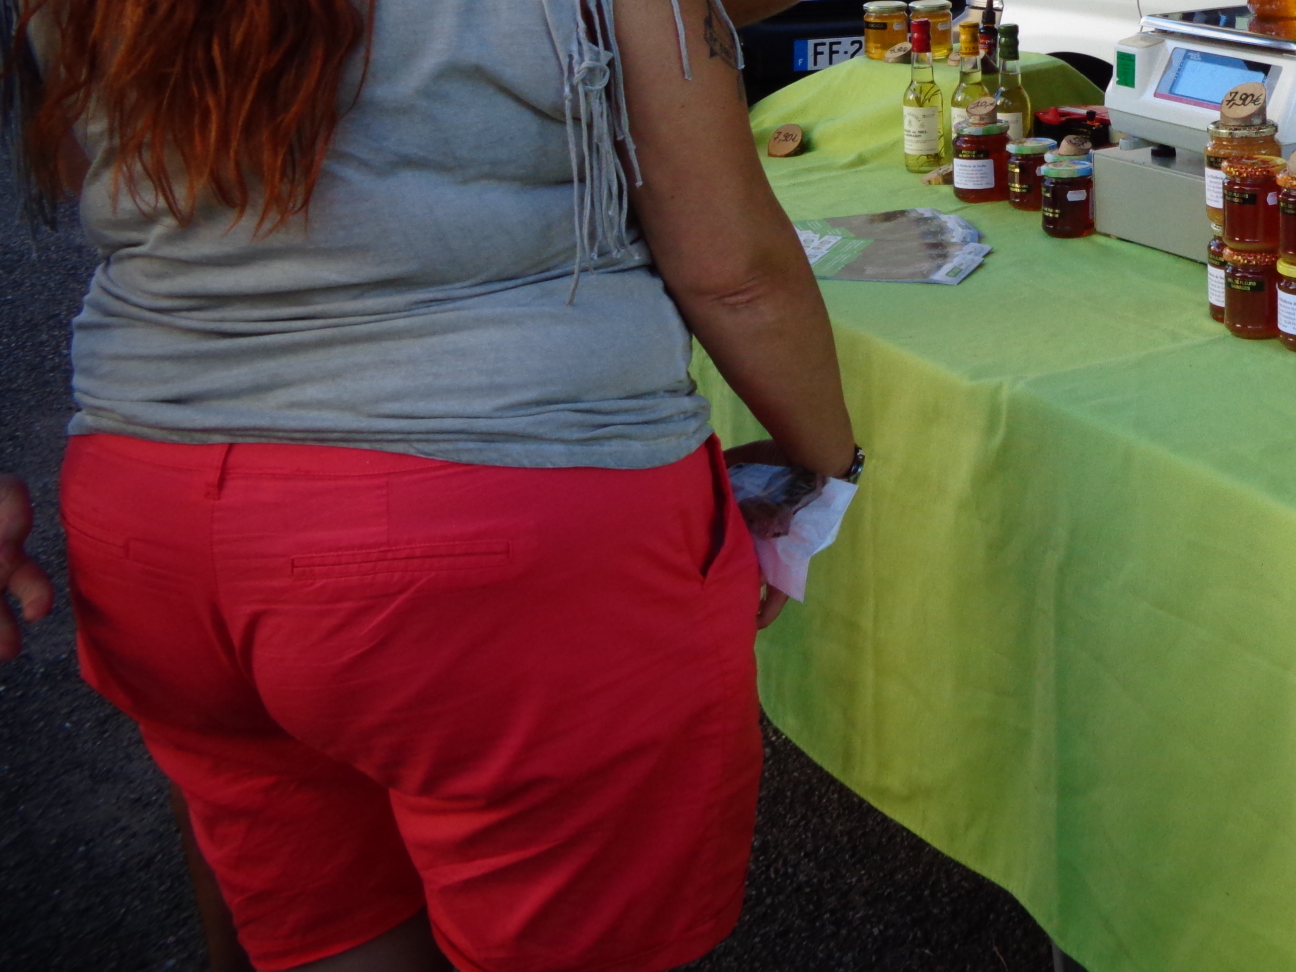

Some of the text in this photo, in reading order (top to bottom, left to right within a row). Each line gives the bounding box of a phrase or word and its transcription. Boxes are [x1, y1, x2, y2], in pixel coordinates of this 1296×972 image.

[798, 58, 804, 66] F
[1226, 91, 1264, 109] 7,90€
[773, 131, 799, 144] 7,90€
